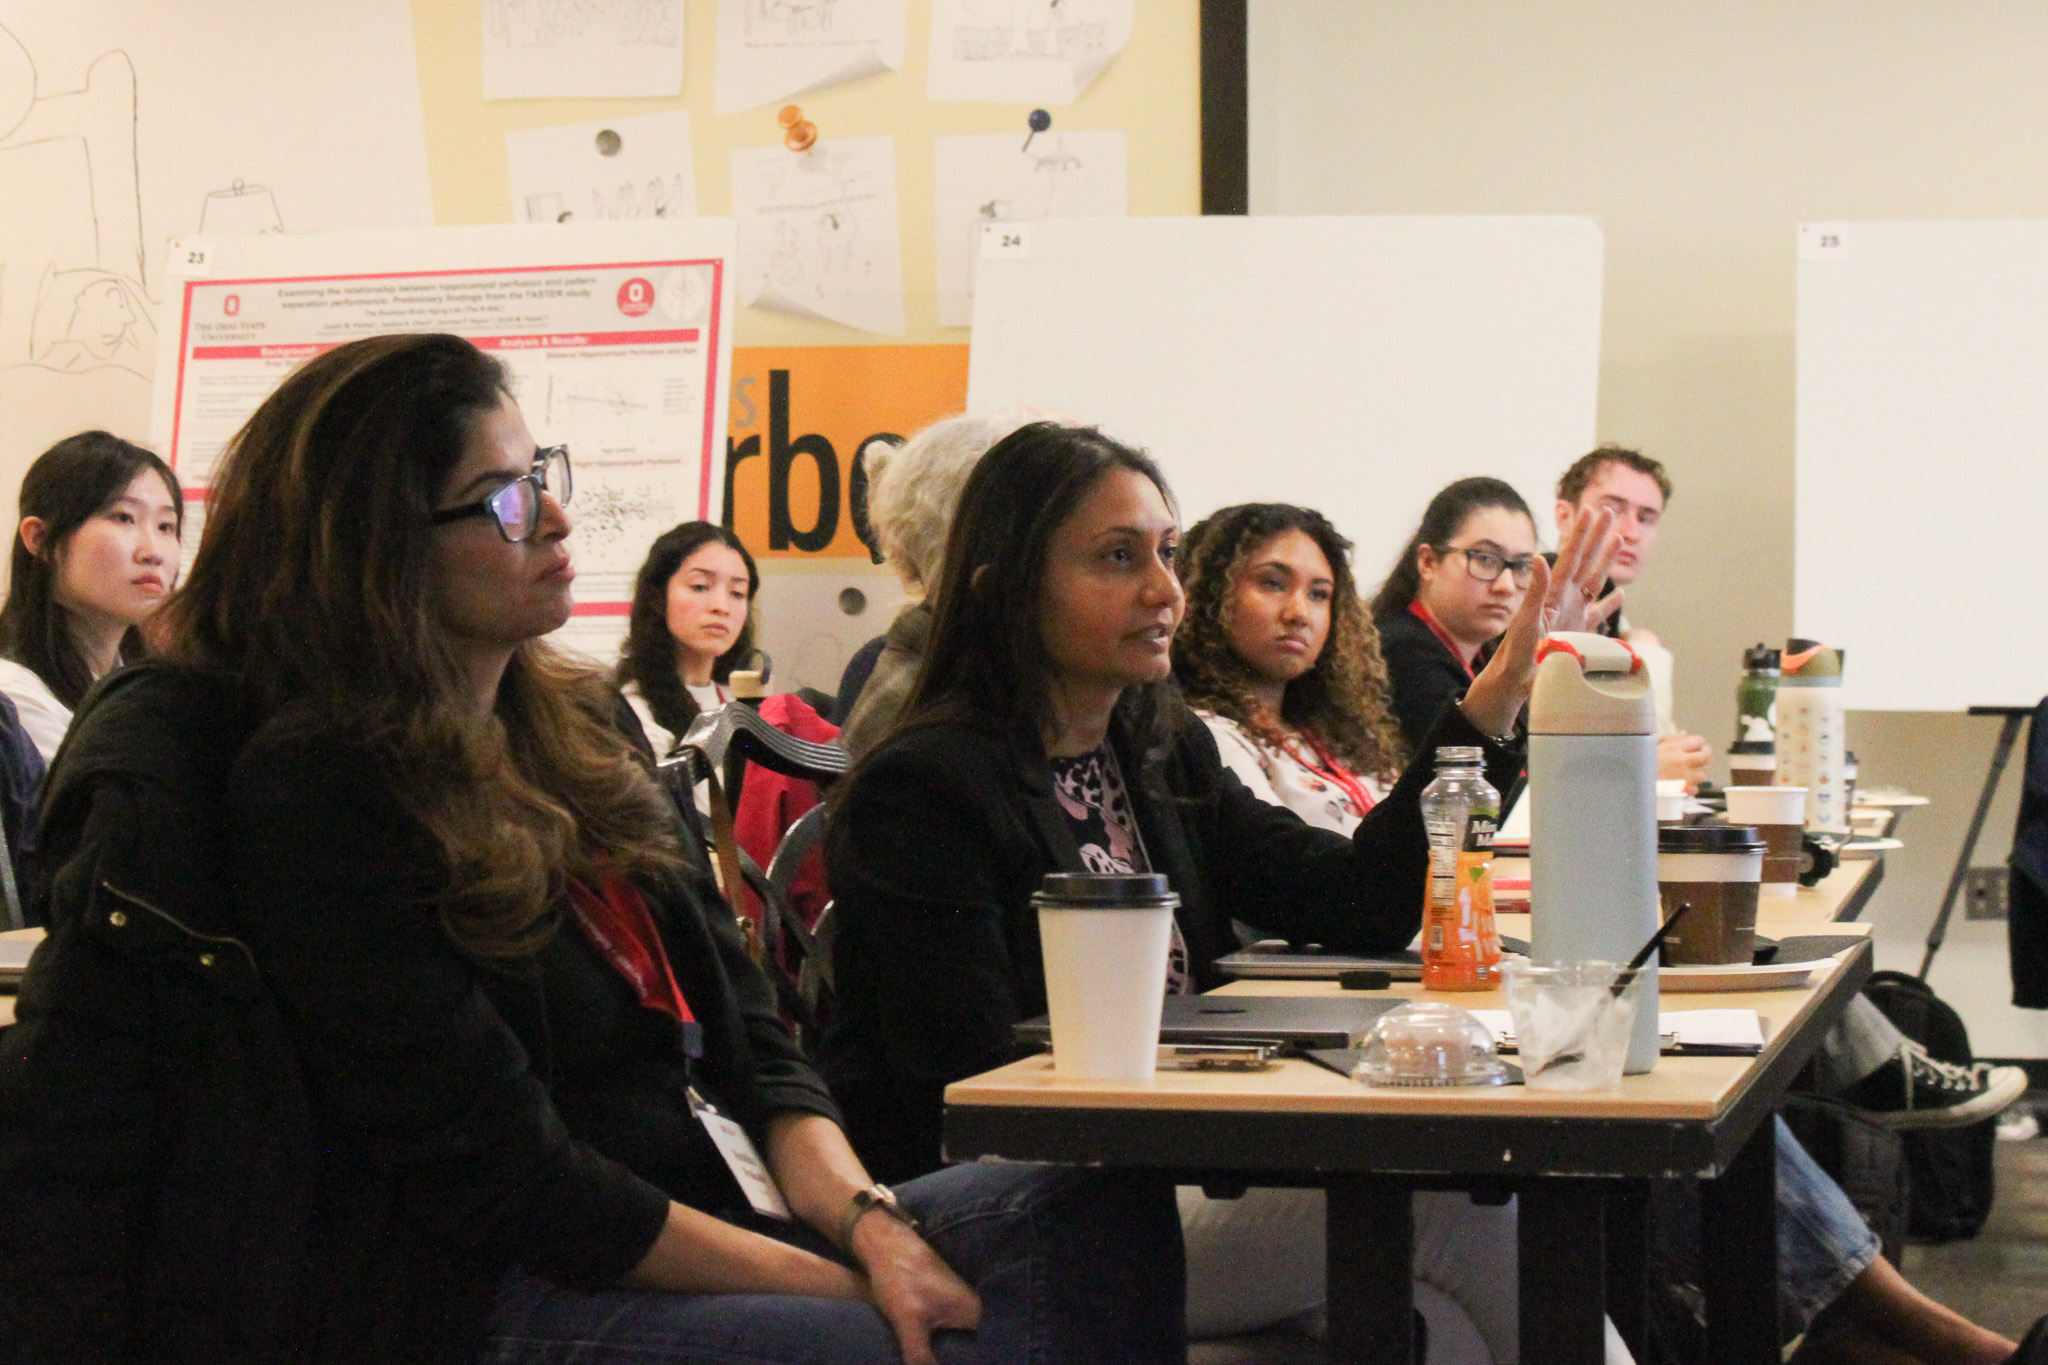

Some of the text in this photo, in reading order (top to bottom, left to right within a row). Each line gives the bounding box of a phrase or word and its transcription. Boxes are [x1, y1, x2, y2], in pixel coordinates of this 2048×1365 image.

[1002, 235, 1020, 247] 24
[1821, 235, 1840, 248] 25
[188, 251, 204, 264] 23
[278, 289, 324, 298] Examining
[344, 286, 395, 296] relationship
[439, 281, 497, 291] hippocampal
[499, 280, 542, 288] perfusion
[393, 296, 443, 305] Preliminary
[485, 292, 506, 300] from
[526, 289, 563, 298] FASTER
[566, 290, 591, 298] study
